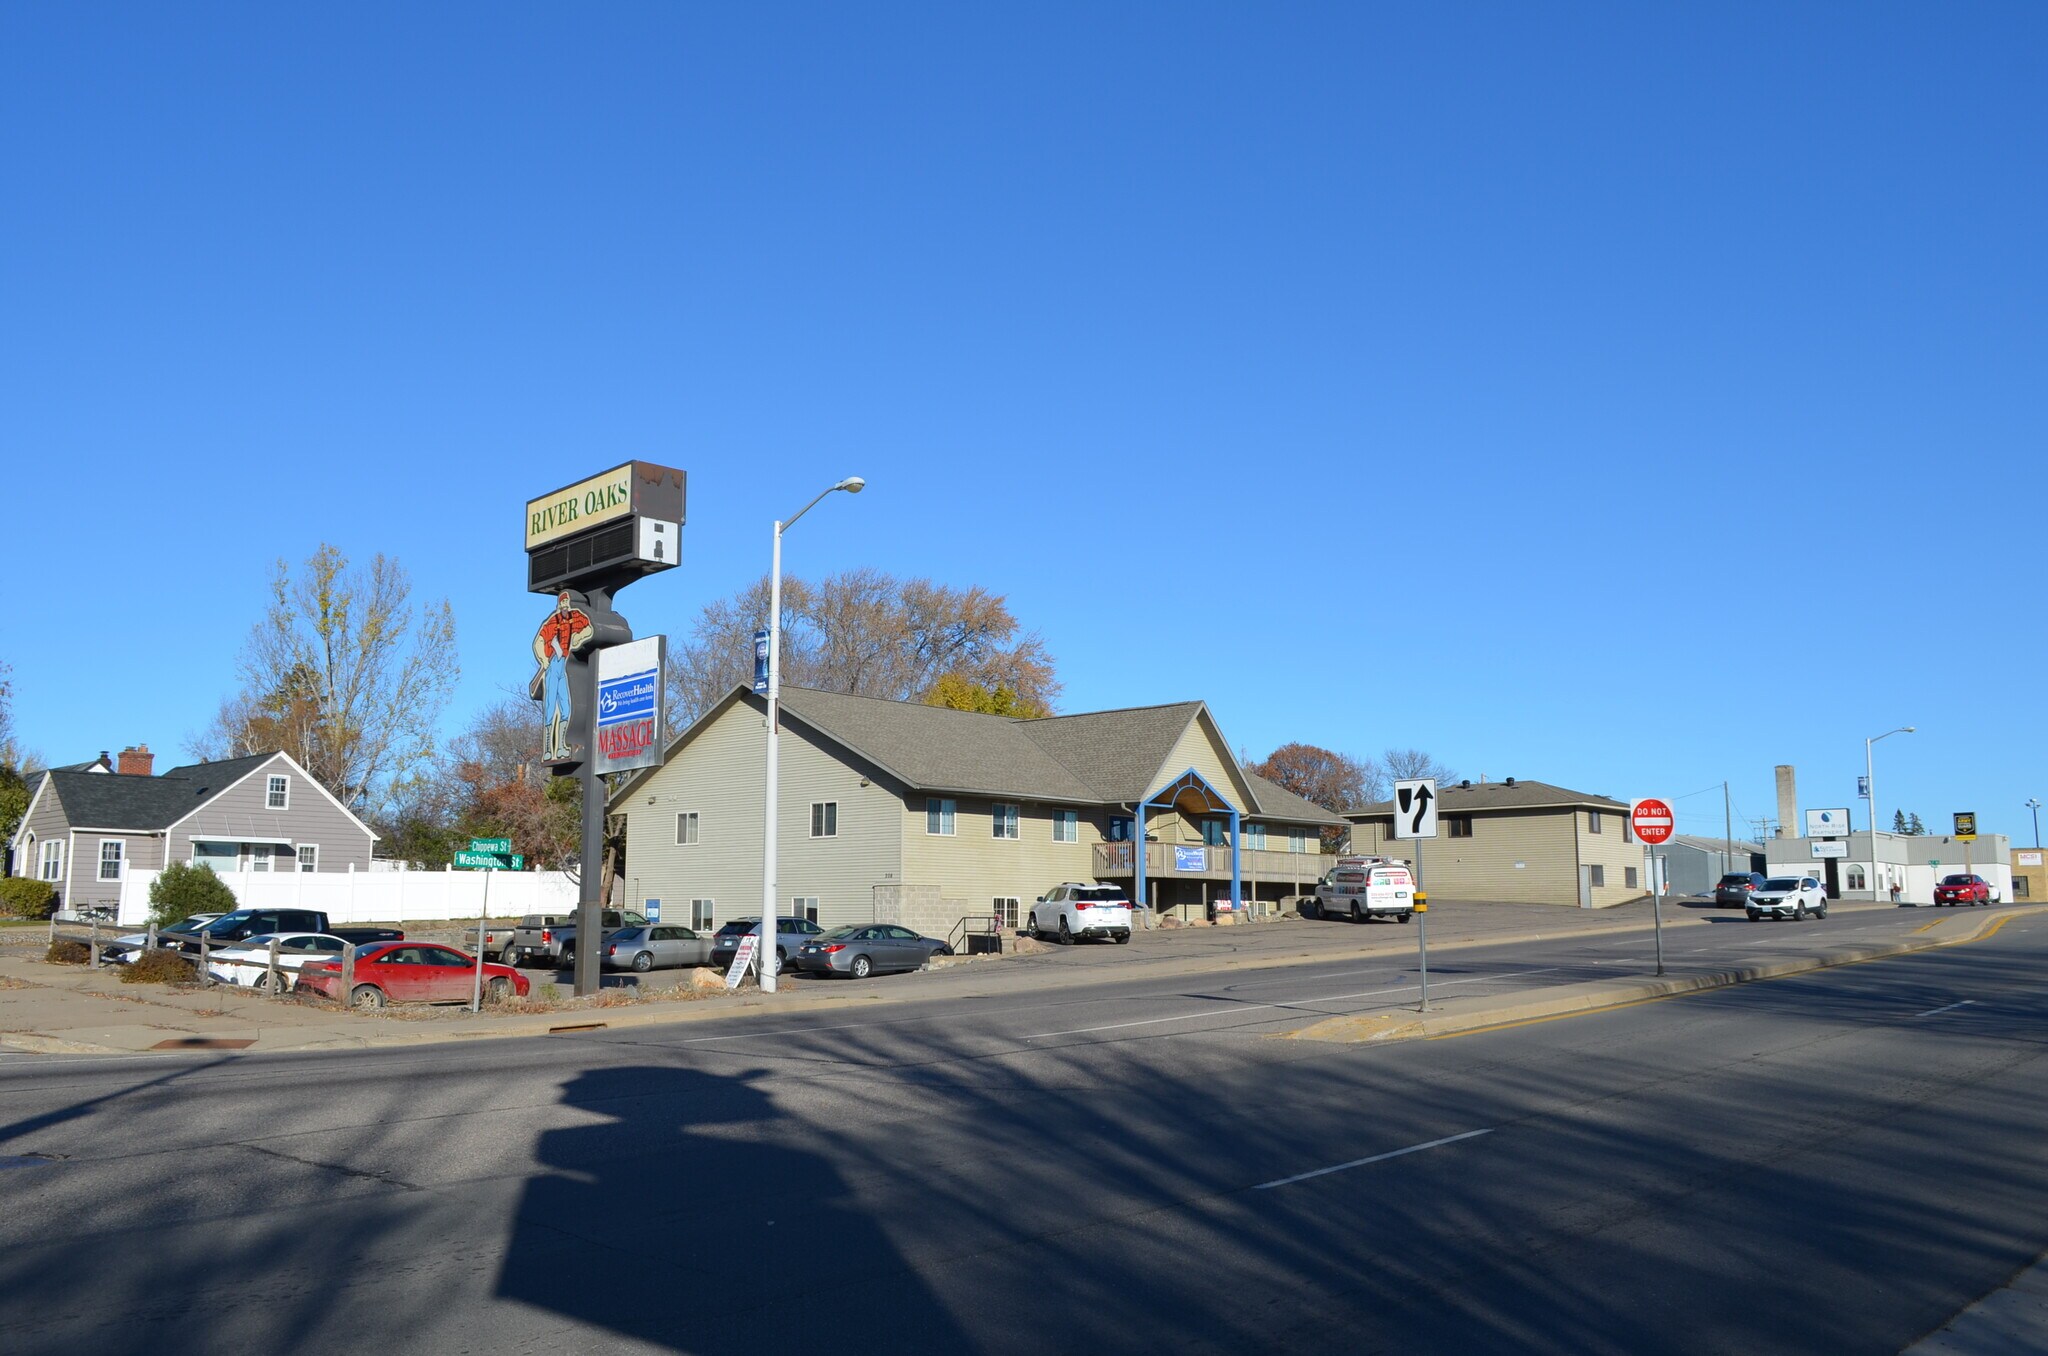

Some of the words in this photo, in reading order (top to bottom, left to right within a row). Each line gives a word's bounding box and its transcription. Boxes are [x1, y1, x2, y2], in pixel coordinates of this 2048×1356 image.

[531, 497, 579, 536] RIVER
[585, 480, 628, 516] OAKS
[612, 682, 654, 699] RecoverHealth
[598, 721, 652, 753] MASSAGE
[472, 841, 498, 853] Chippewa
[500, 841, 507, 852] St
[459, 853, 507, 868] Washington
[511, 856, 520, 868] St
